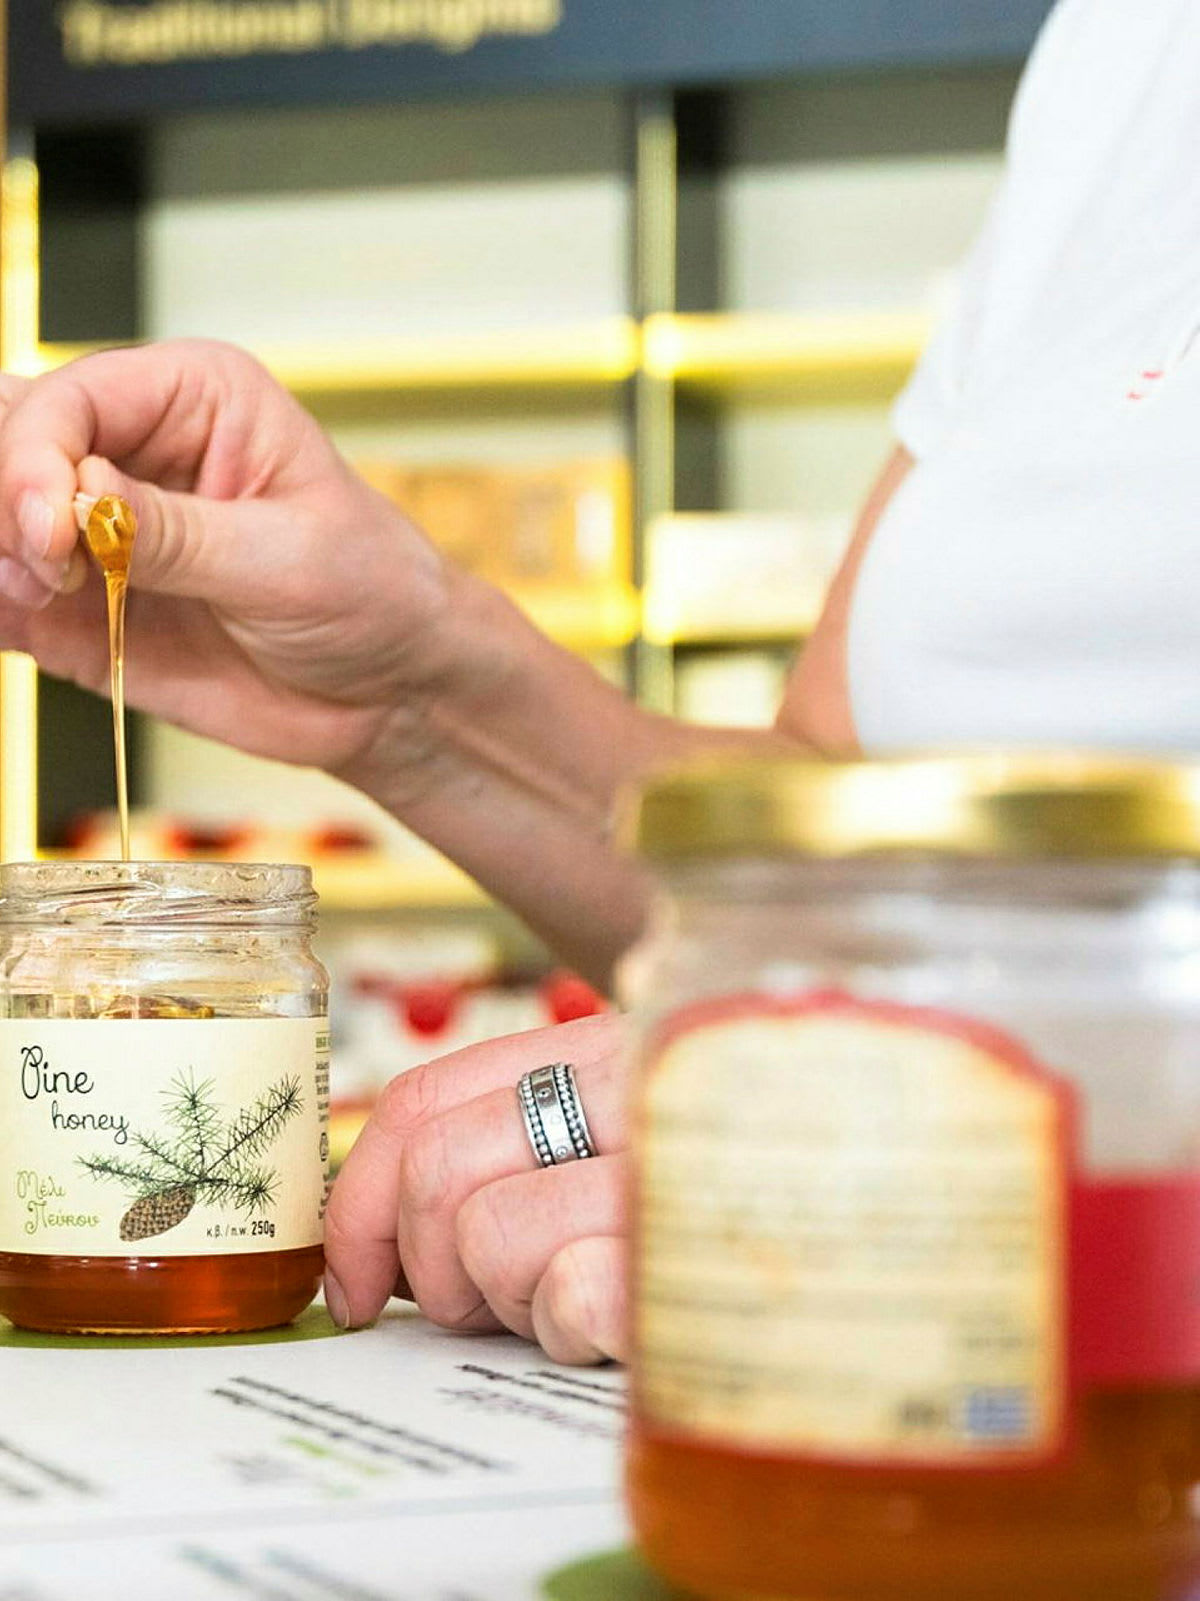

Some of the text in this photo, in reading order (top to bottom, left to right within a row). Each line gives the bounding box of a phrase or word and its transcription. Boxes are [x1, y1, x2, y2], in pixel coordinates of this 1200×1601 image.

[20, 1044, 95, 1100] Pine
[51, 1099, 130, 1145] honey
[251, 1219, 276, 1239] 250g
